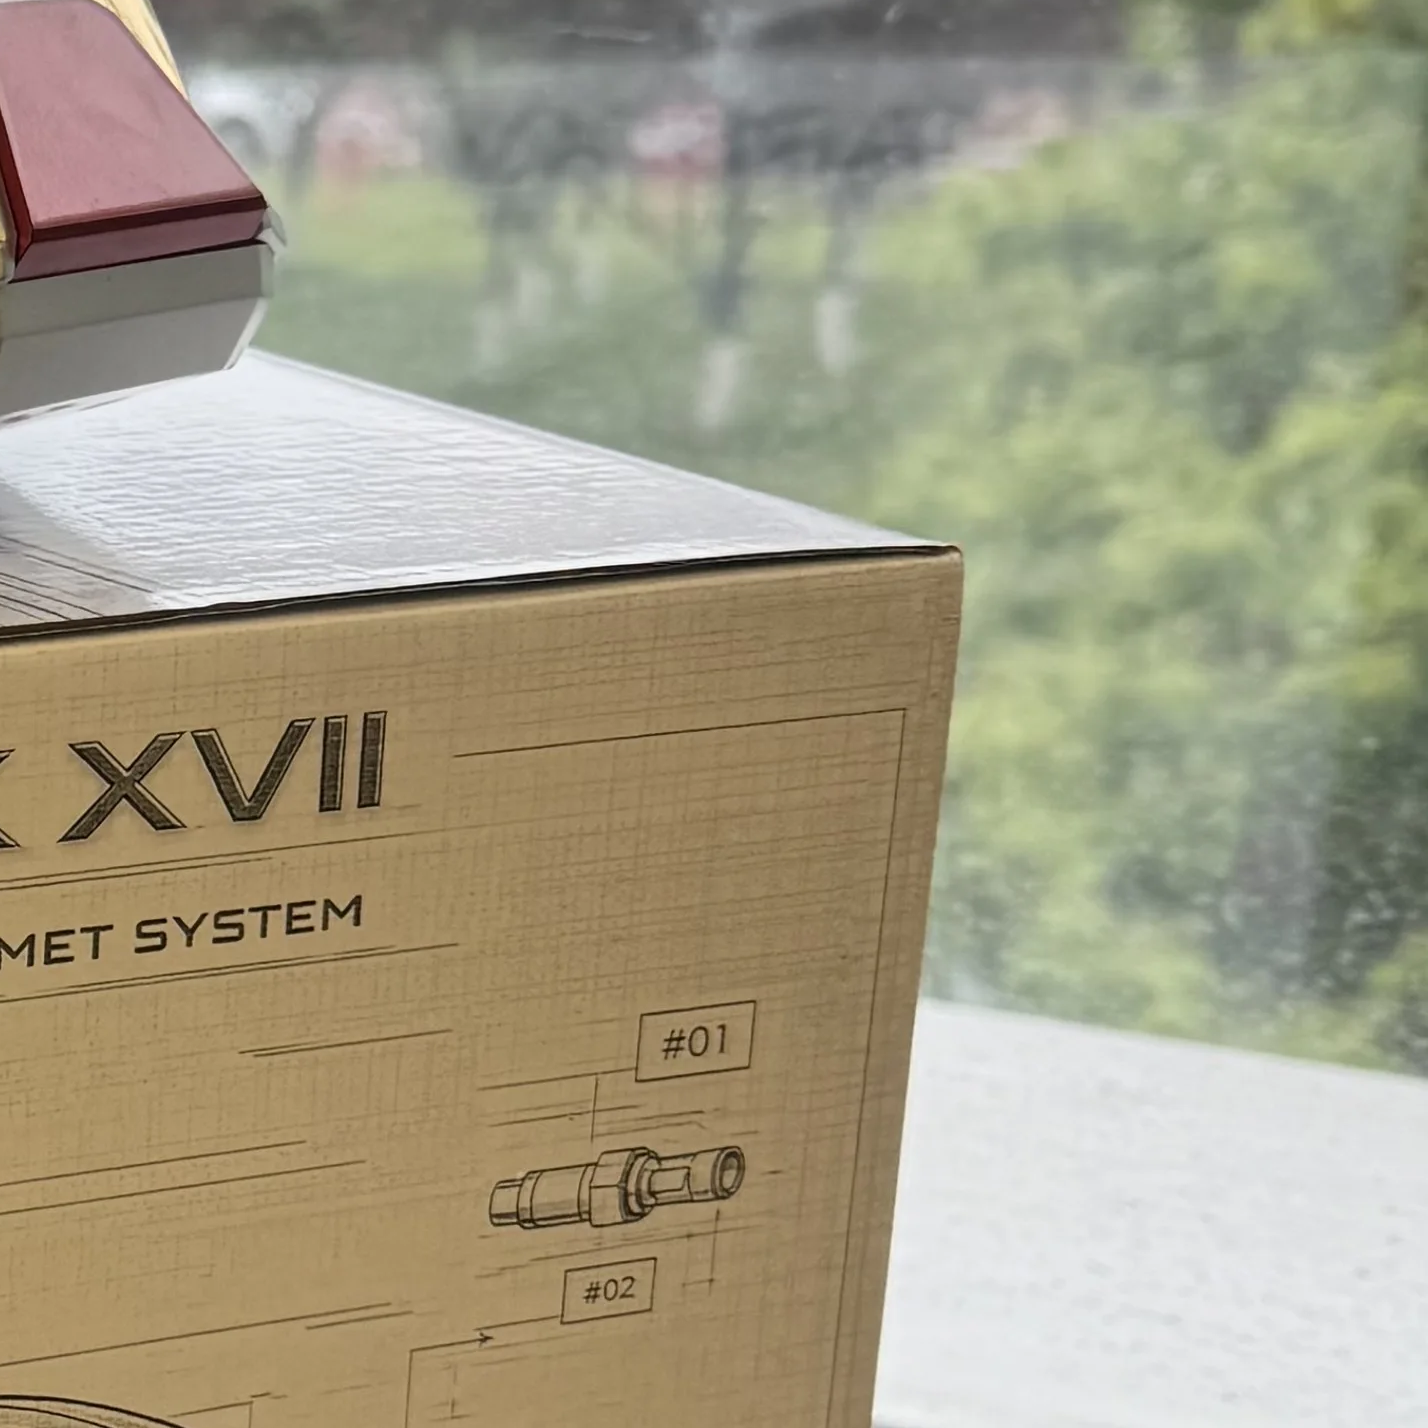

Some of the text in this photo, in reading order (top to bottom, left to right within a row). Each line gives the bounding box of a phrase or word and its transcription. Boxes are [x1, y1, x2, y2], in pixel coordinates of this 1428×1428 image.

[57, 710, 388, 844] XVII
[133, 894, 364, 955] SYSTEM
[661, 1023, 729, 1060] #01
[582, 1276, 636, 1303] #02
